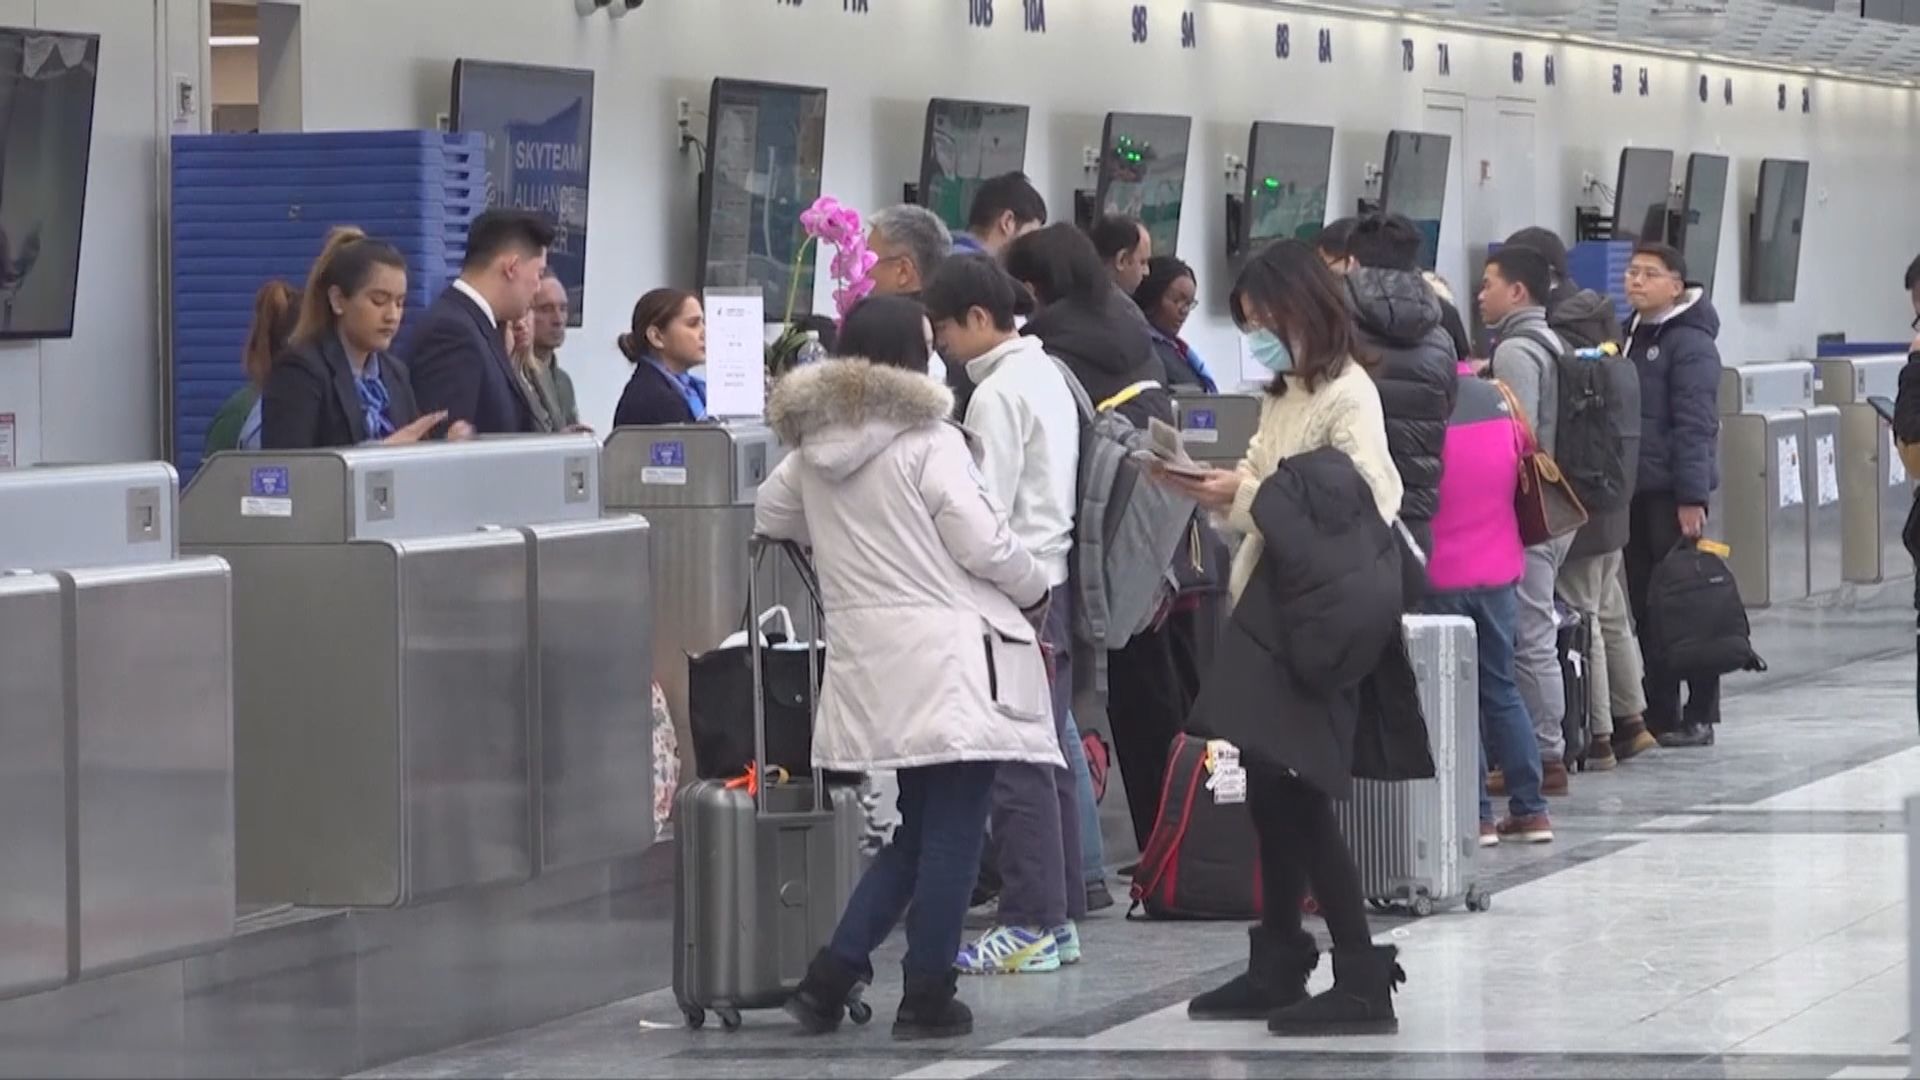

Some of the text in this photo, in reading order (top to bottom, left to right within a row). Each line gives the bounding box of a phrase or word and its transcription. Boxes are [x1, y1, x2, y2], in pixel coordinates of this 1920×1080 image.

[969, 0, 1046, 34] 10B 10A
[1132, 5, 1196, 49] 9B 9A
[1276, 23, 1332, 63] 8B 8A
[1402, 38, 1450, 76] 7B 7A
[1544, 54, 1555, 86] 6A
[1612, 63, 1649, 96] 5B 5A
[515, 140, 584, 172] SKYTEAM
[515, 184, 577, 212] ALLIANCE
